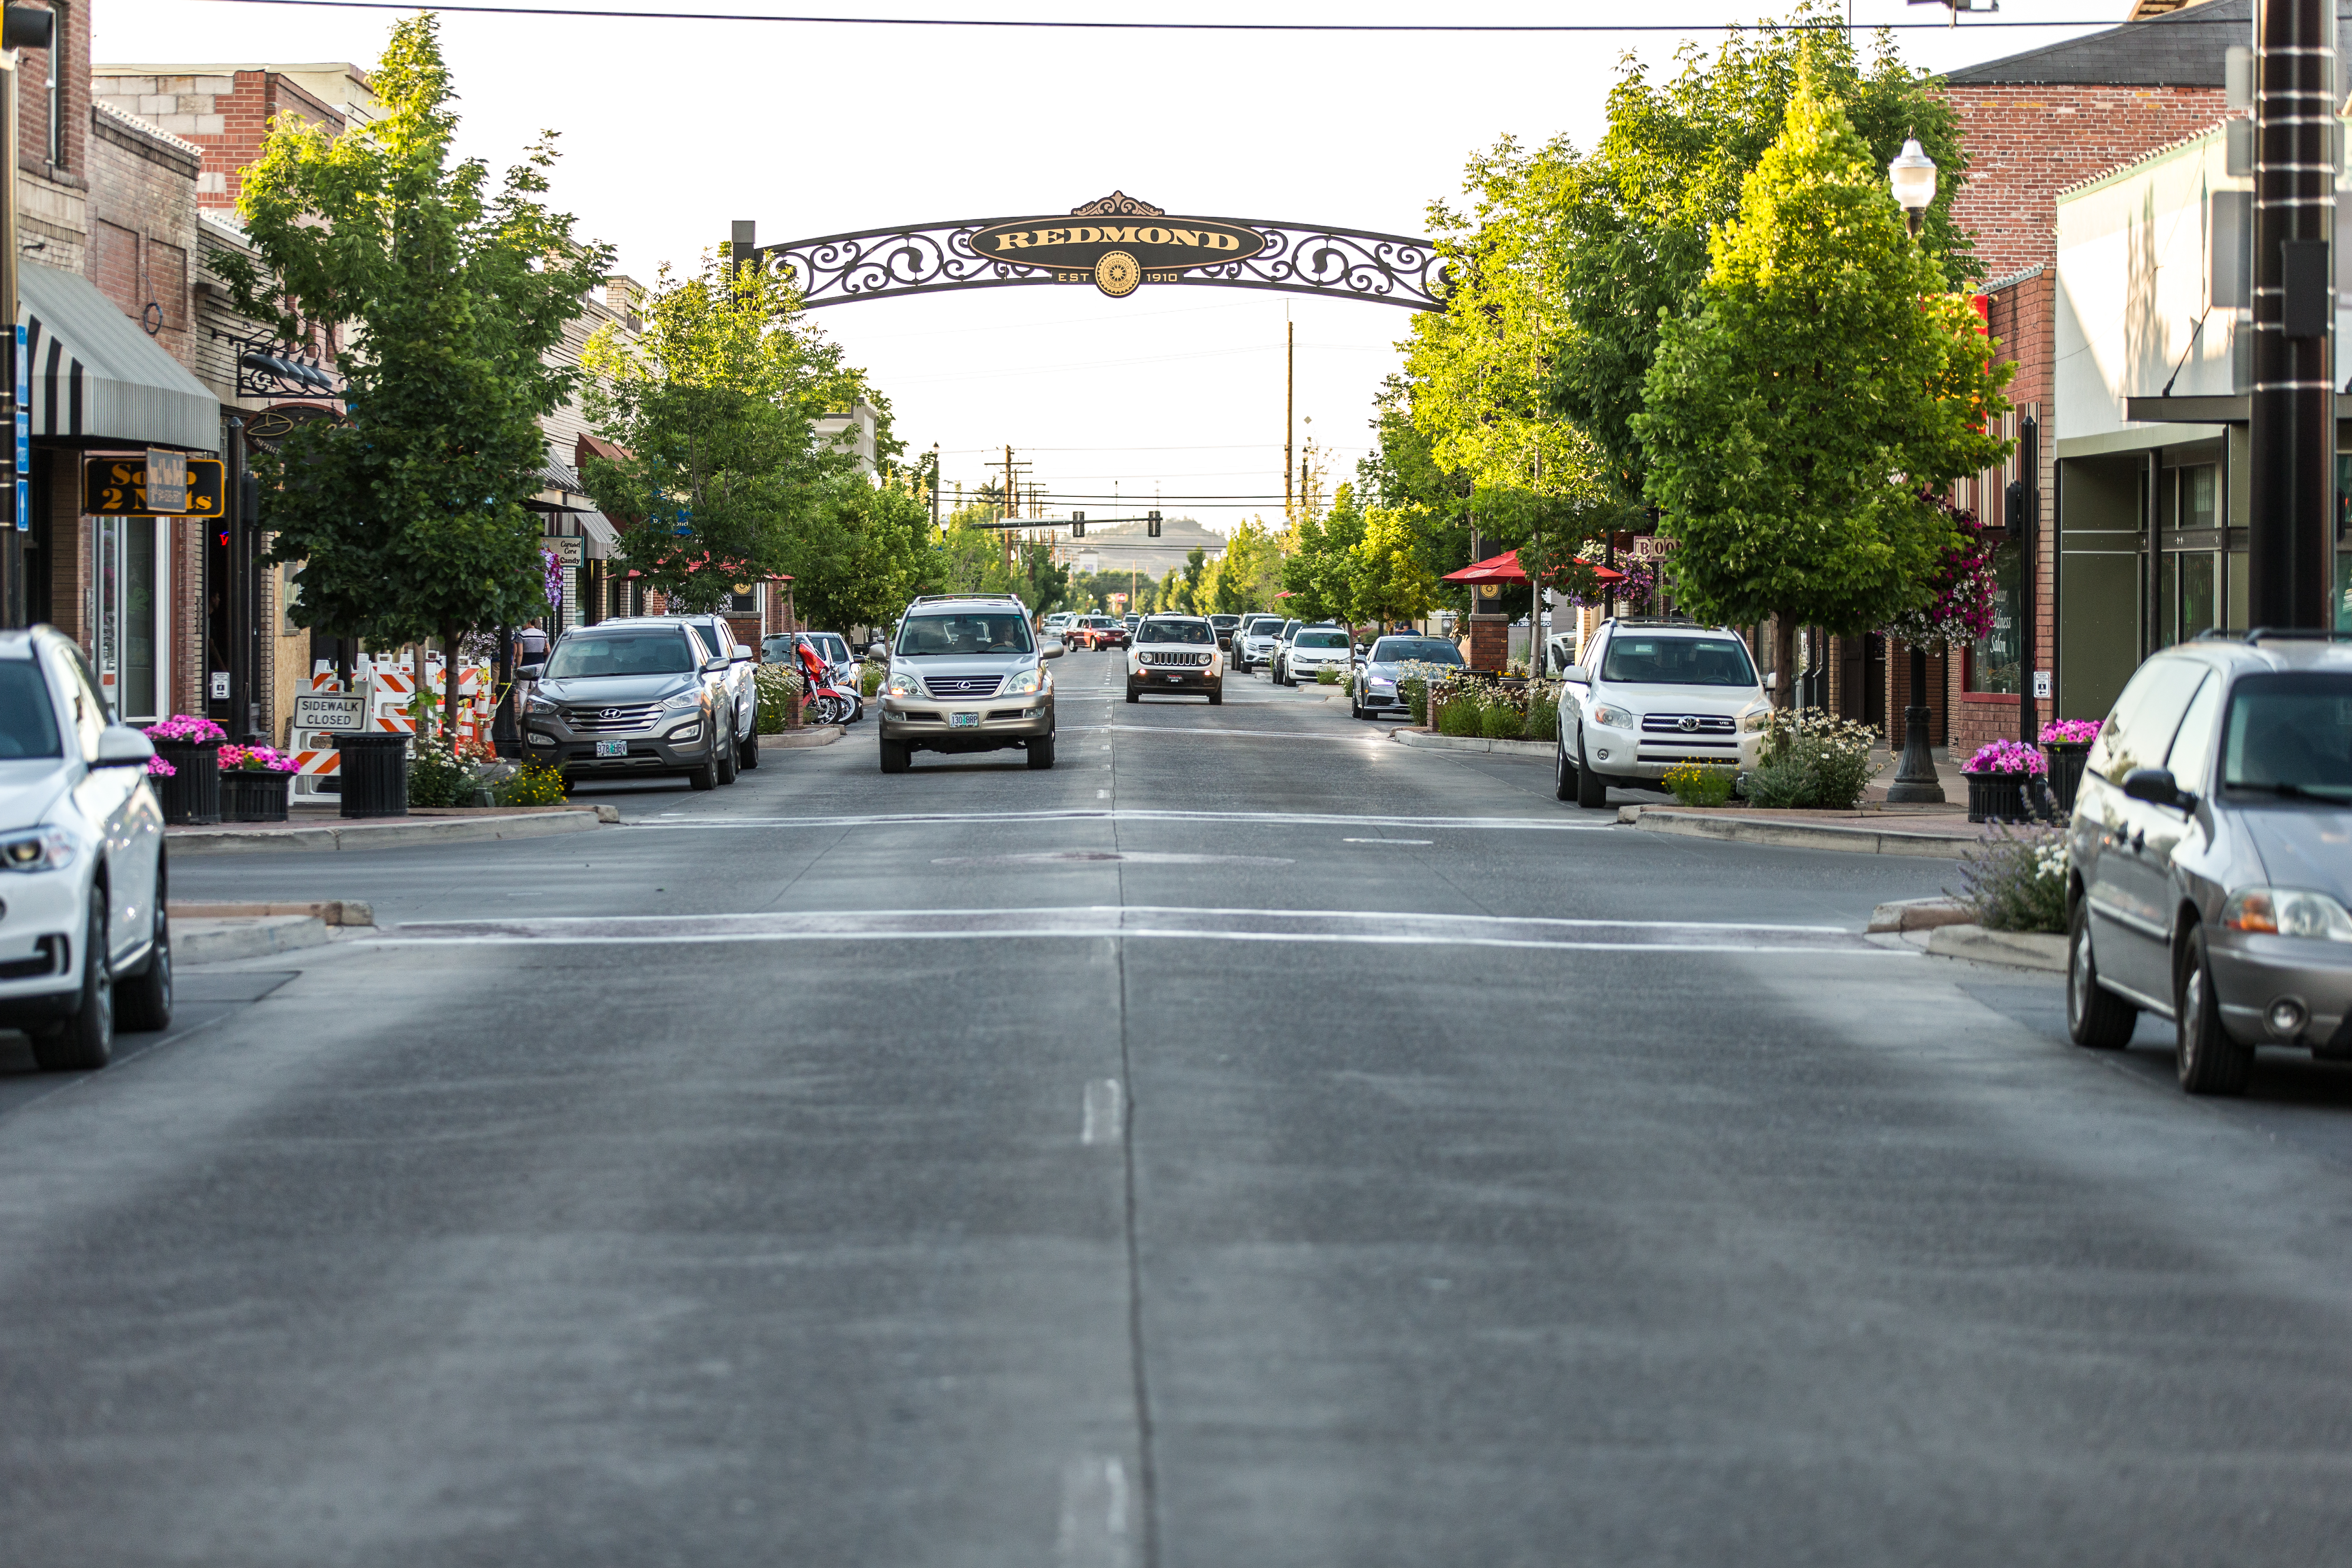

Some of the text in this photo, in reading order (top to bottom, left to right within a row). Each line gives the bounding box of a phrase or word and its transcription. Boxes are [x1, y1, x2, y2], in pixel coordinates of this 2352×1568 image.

[995, 227, 1240, 251] REDMOND
[1106, 260, 1130, 270] REDMOND
[1058, 273, 1089, 282] EST
[1146, 274, 1178, 282] 1910
[1107, 279, 1129, 287] THE HUB
[102, 488, 123, 510] 2
[1640, 541, 1682, 554] BOO
[560, 557, 580, 565] Candy
[1990, 633, 2006, 653] Salon
[302, 701, 358, 711] SIDEWALK
[307, 715, 351, 725] CLOSED
[952, 715, 977, 724] 130 BRP
[598, 744, 626, 753] 378 HBV
